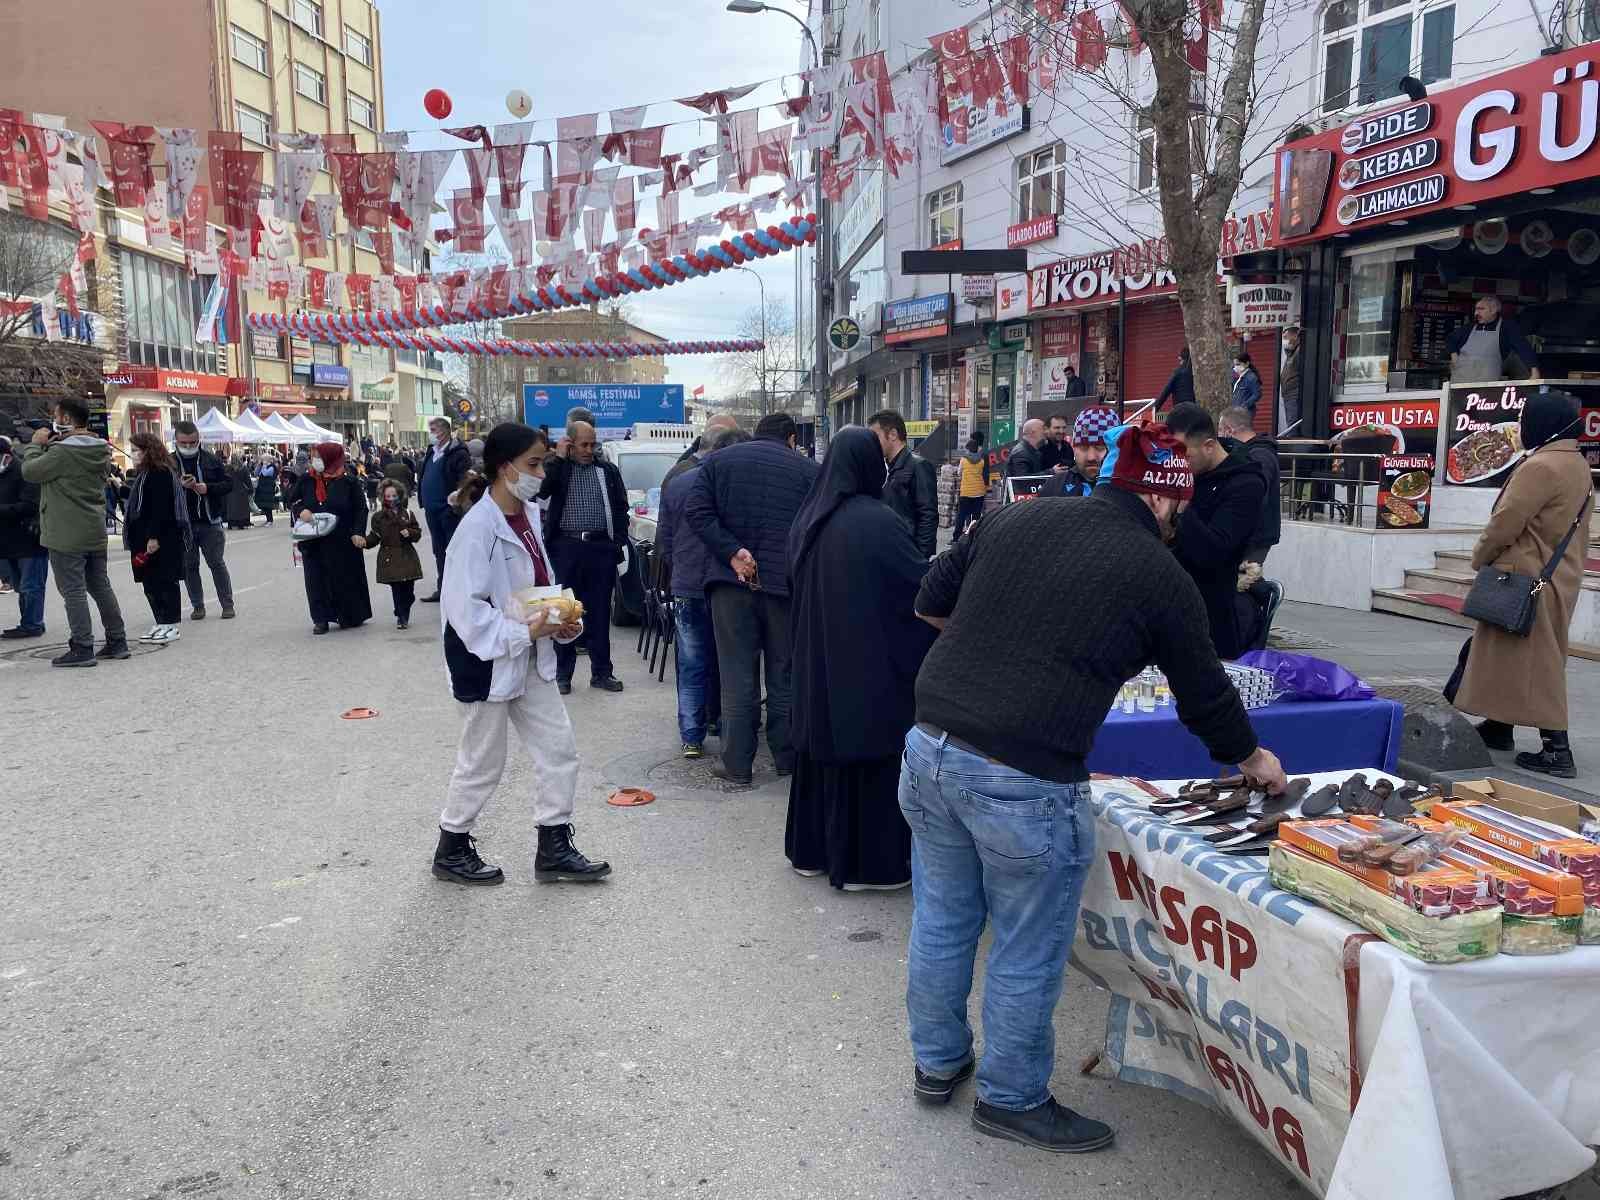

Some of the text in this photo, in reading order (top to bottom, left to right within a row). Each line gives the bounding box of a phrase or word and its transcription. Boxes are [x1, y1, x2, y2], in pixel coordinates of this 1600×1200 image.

[1453, 60, 1600, 182] GÜ
[1362, 143, 1428, 180] KEBAP
[1360, 178, 1440, 216] LAHMACUN
[1053, 254, 1114, 277] OLİMPİYAT
[1238, 288, 1263, 303] FOTO
[166, 376, 199, 390] AKBANK
[1466, 393, 1498, 411] Pilav
[1333, 406, 1434, 426] GÜVEN USTA
[1383, 456, 1429, 469] GÜVEN USTA
